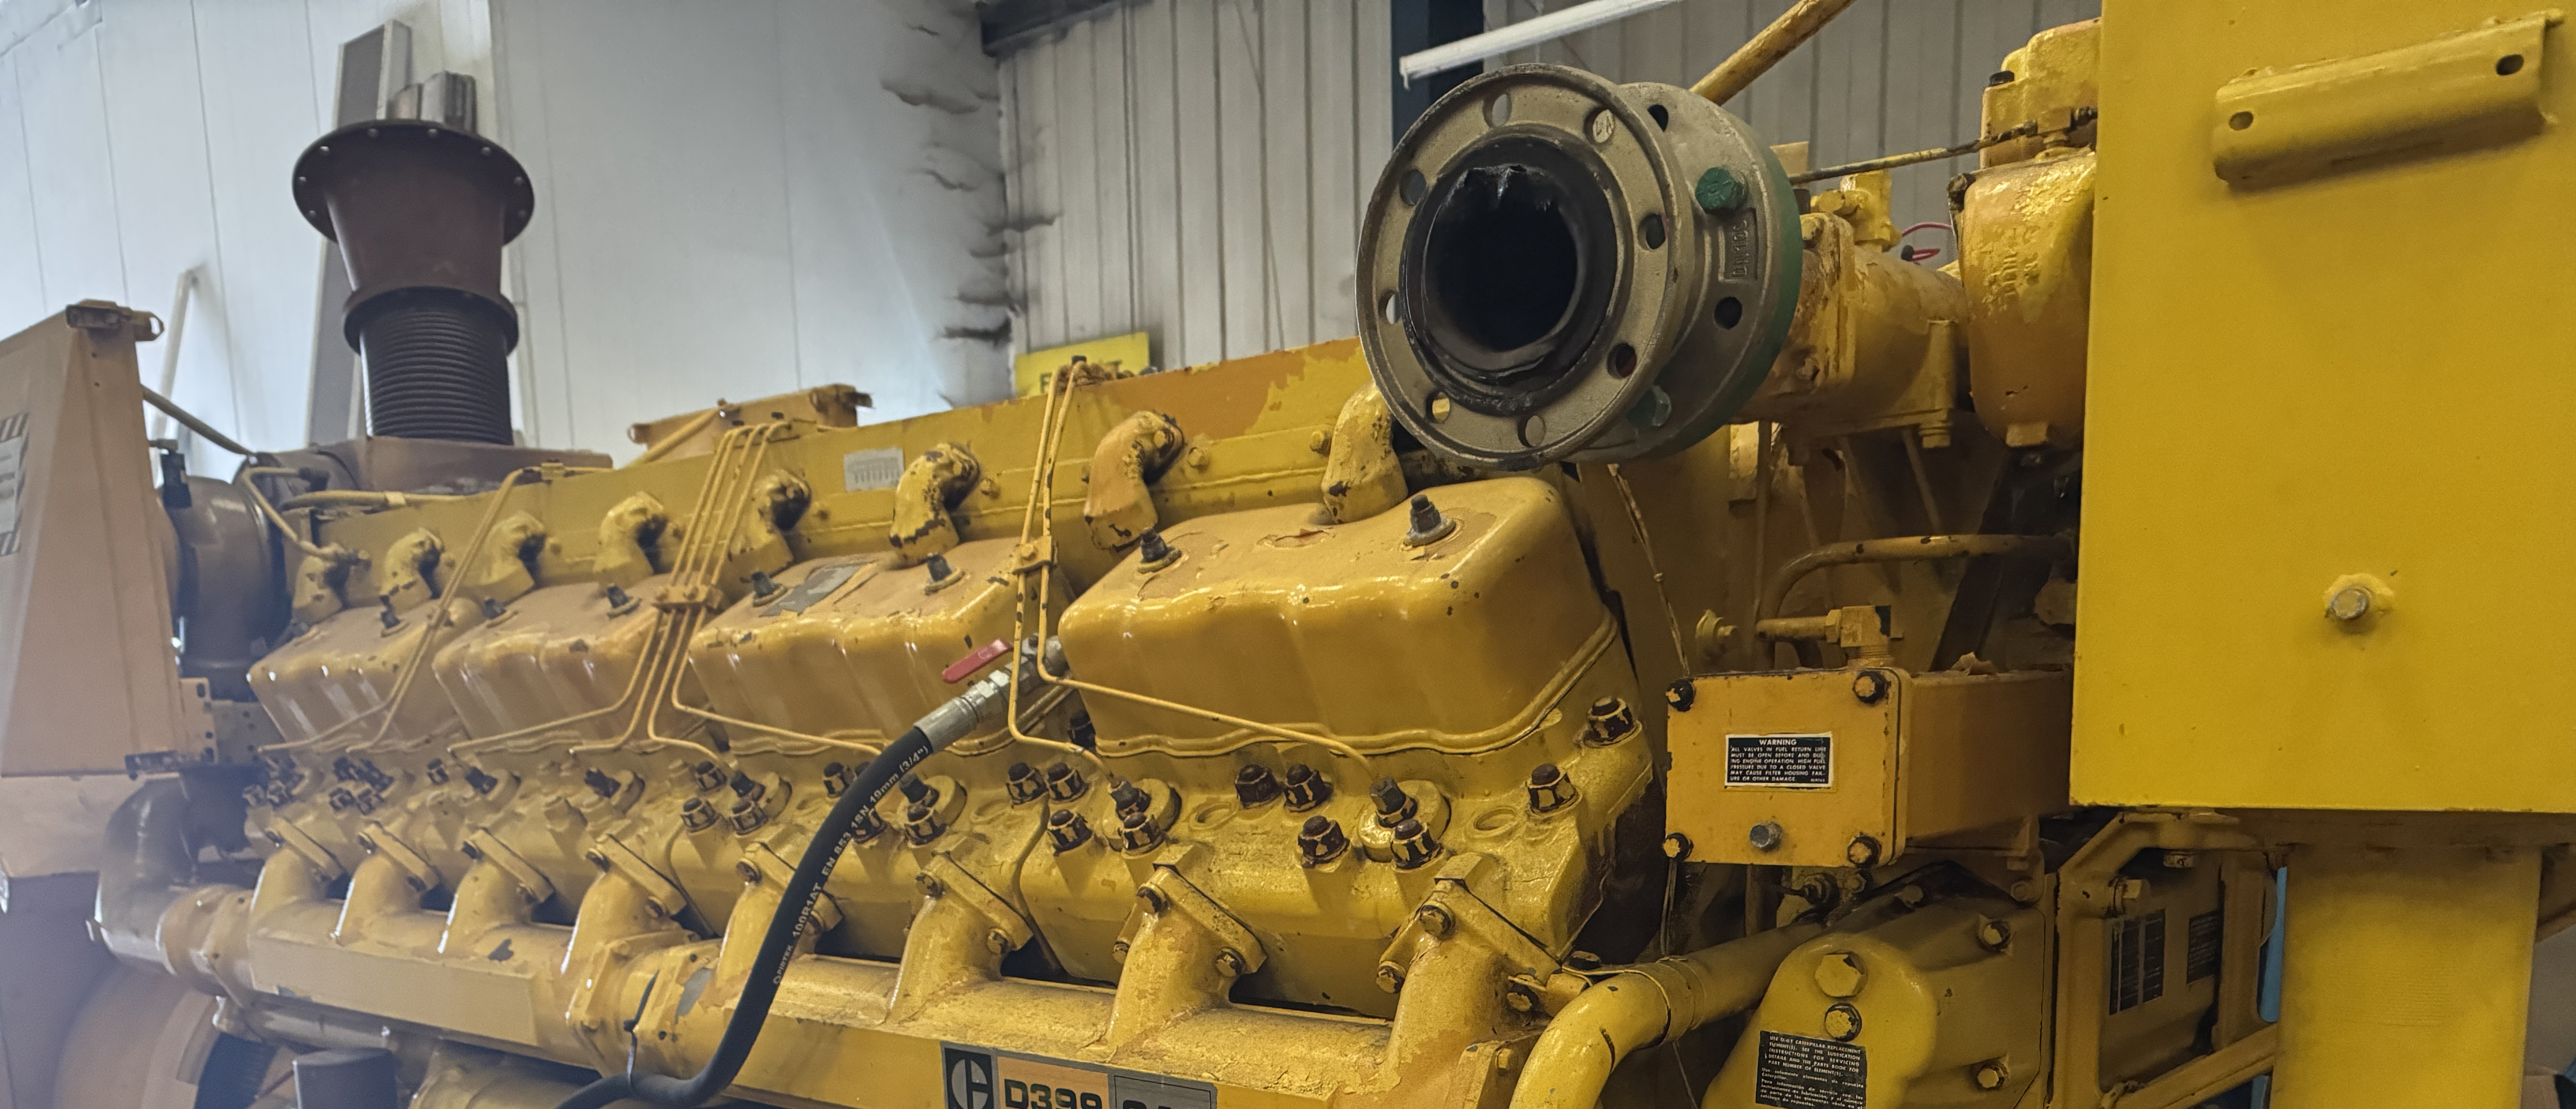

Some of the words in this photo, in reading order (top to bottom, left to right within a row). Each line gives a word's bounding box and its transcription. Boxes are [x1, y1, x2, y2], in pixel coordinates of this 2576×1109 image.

[776, 944, 794, 976] PIRTEK
[792, 882, 822, 938] 100R1AT
[821, 856, 836, 877] EN
[834, 831, 851, 855] 853
[851, 805, 870, 829] 1SN
[870, 773, 899, 803] 19mm
[899, 745, 928, 773] (3/4")
[1795, 1040, 1825, 1048] CATERPILLAR
[1827, 1045, 1860, 1054] REPLACEMENT
[1769, 1047, 1808, 1057] INSTRUCTIONS
[1830, 1057, 1859, 1066] SERVICING
[1828, 1051, 1860, 1060] LUBRICATION
